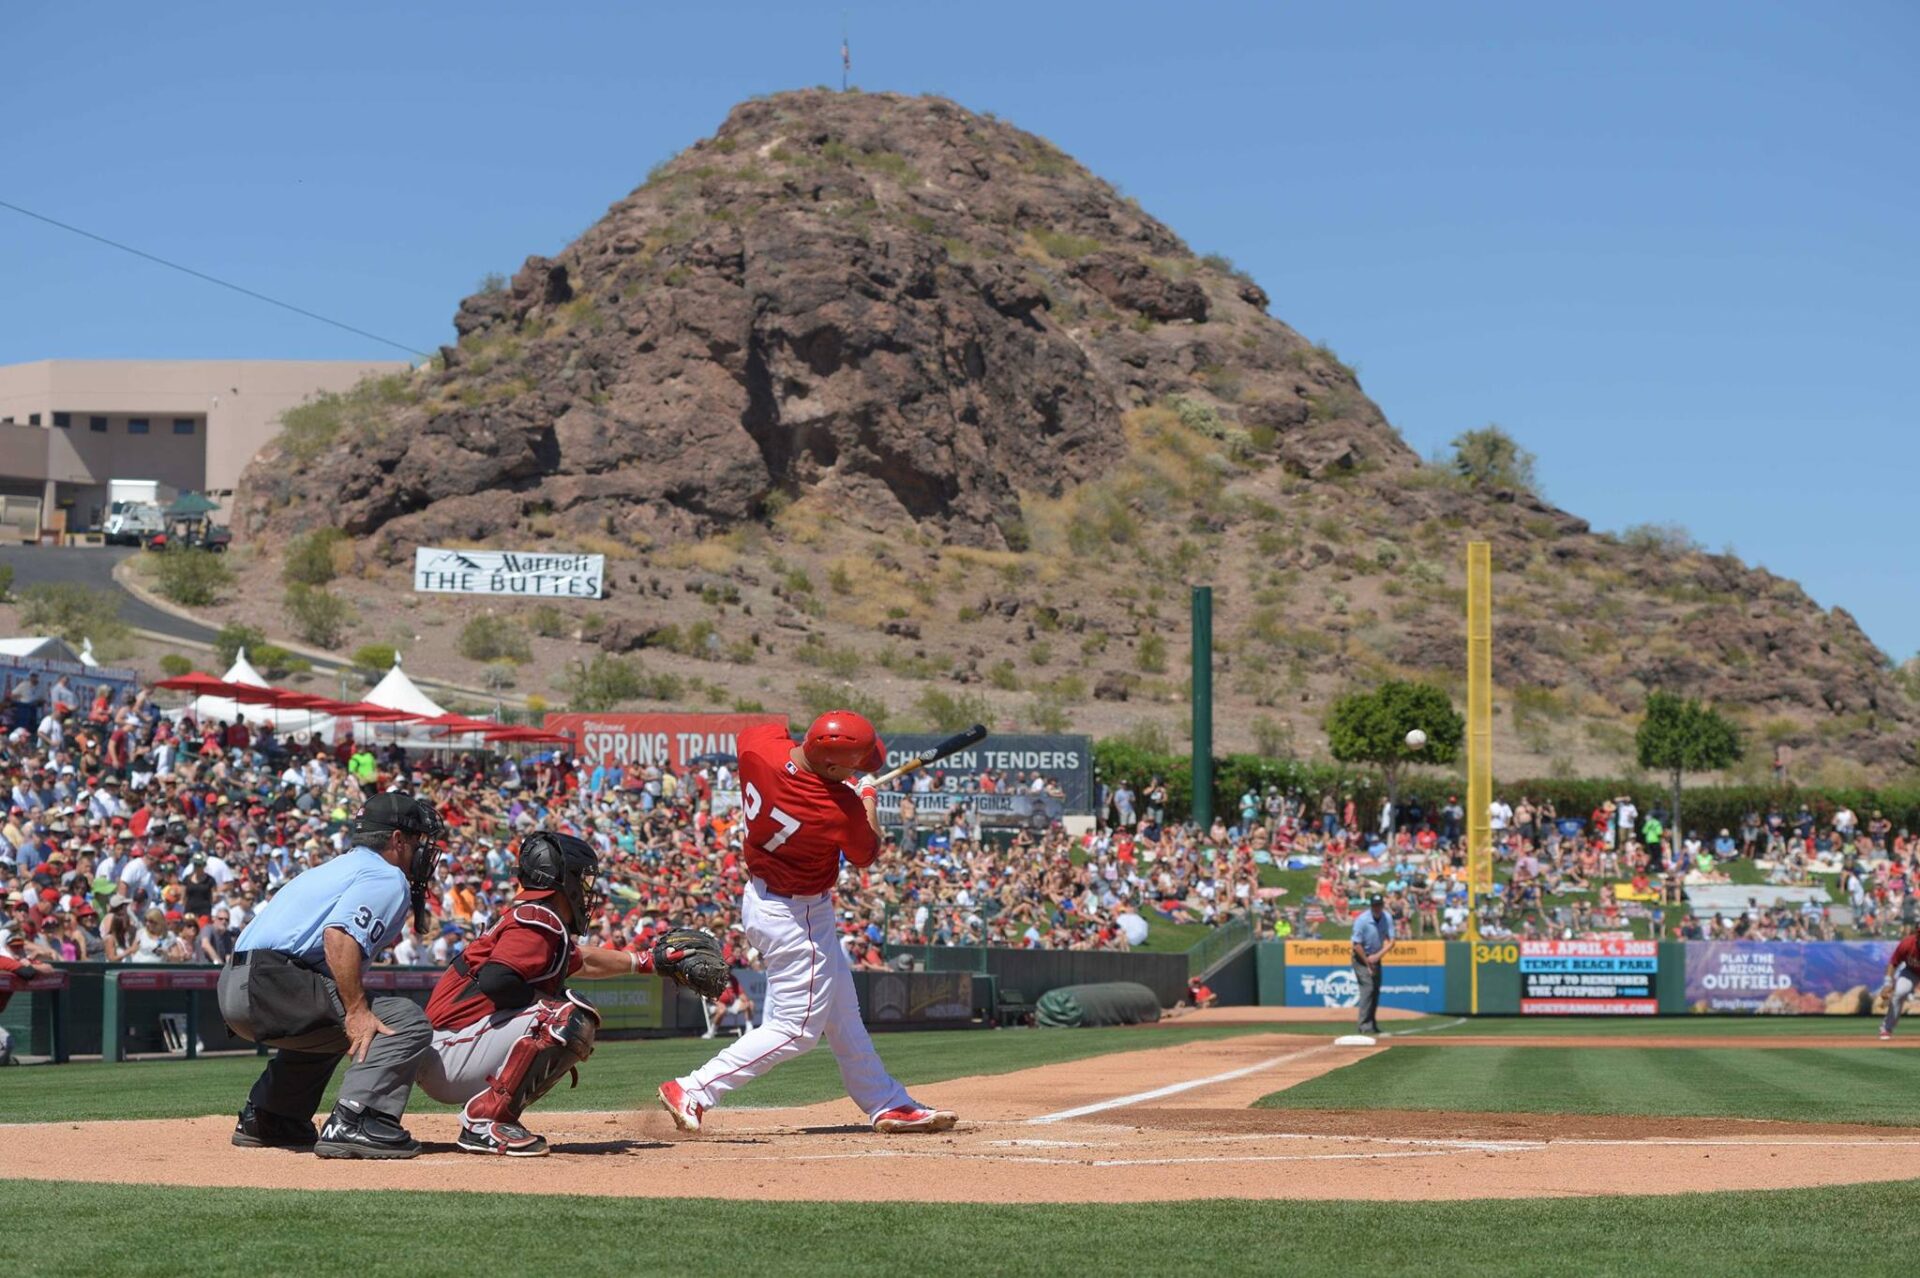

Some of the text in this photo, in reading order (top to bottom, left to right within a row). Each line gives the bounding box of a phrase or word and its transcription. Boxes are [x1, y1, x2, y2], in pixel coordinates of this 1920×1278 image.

[496, 553, 588, 573] Marriott
[421, 571, 598, 596] THE BUTTES
[584, 732, 738, 767] SPRING TRAIN
[886, 751, 977, 769] CHIKEN
[984, 751, 1079, 769] TENDERS
[914, 795, 950, 809] TIME
[743, 782, 802, 853] 27
[353, 904, 386, 944] 30
[1293, 944, 1330, 957] Tempe
[1476, 945, 1519, 964] 340
[1522, 941, 1553, 955] SAT.
[1557, 941, 1604, 955] APRIL
[1623, 941, 1656, 955] 2015
[1524, 959, 1654, 970] TEMPE BEACH PARK
[1720, 953, 1775, 964] PLAY THE
[1720, 964, 1775, 974] ARIZONA
[1527, 975, 1649, 986] A DAY TO REMEMBER
[1702, 974, 1793, 990] OUTFIELD
[1527, 986, 1552, 997] THE
[1553, 986, 1617, 997] OFFSPRING
